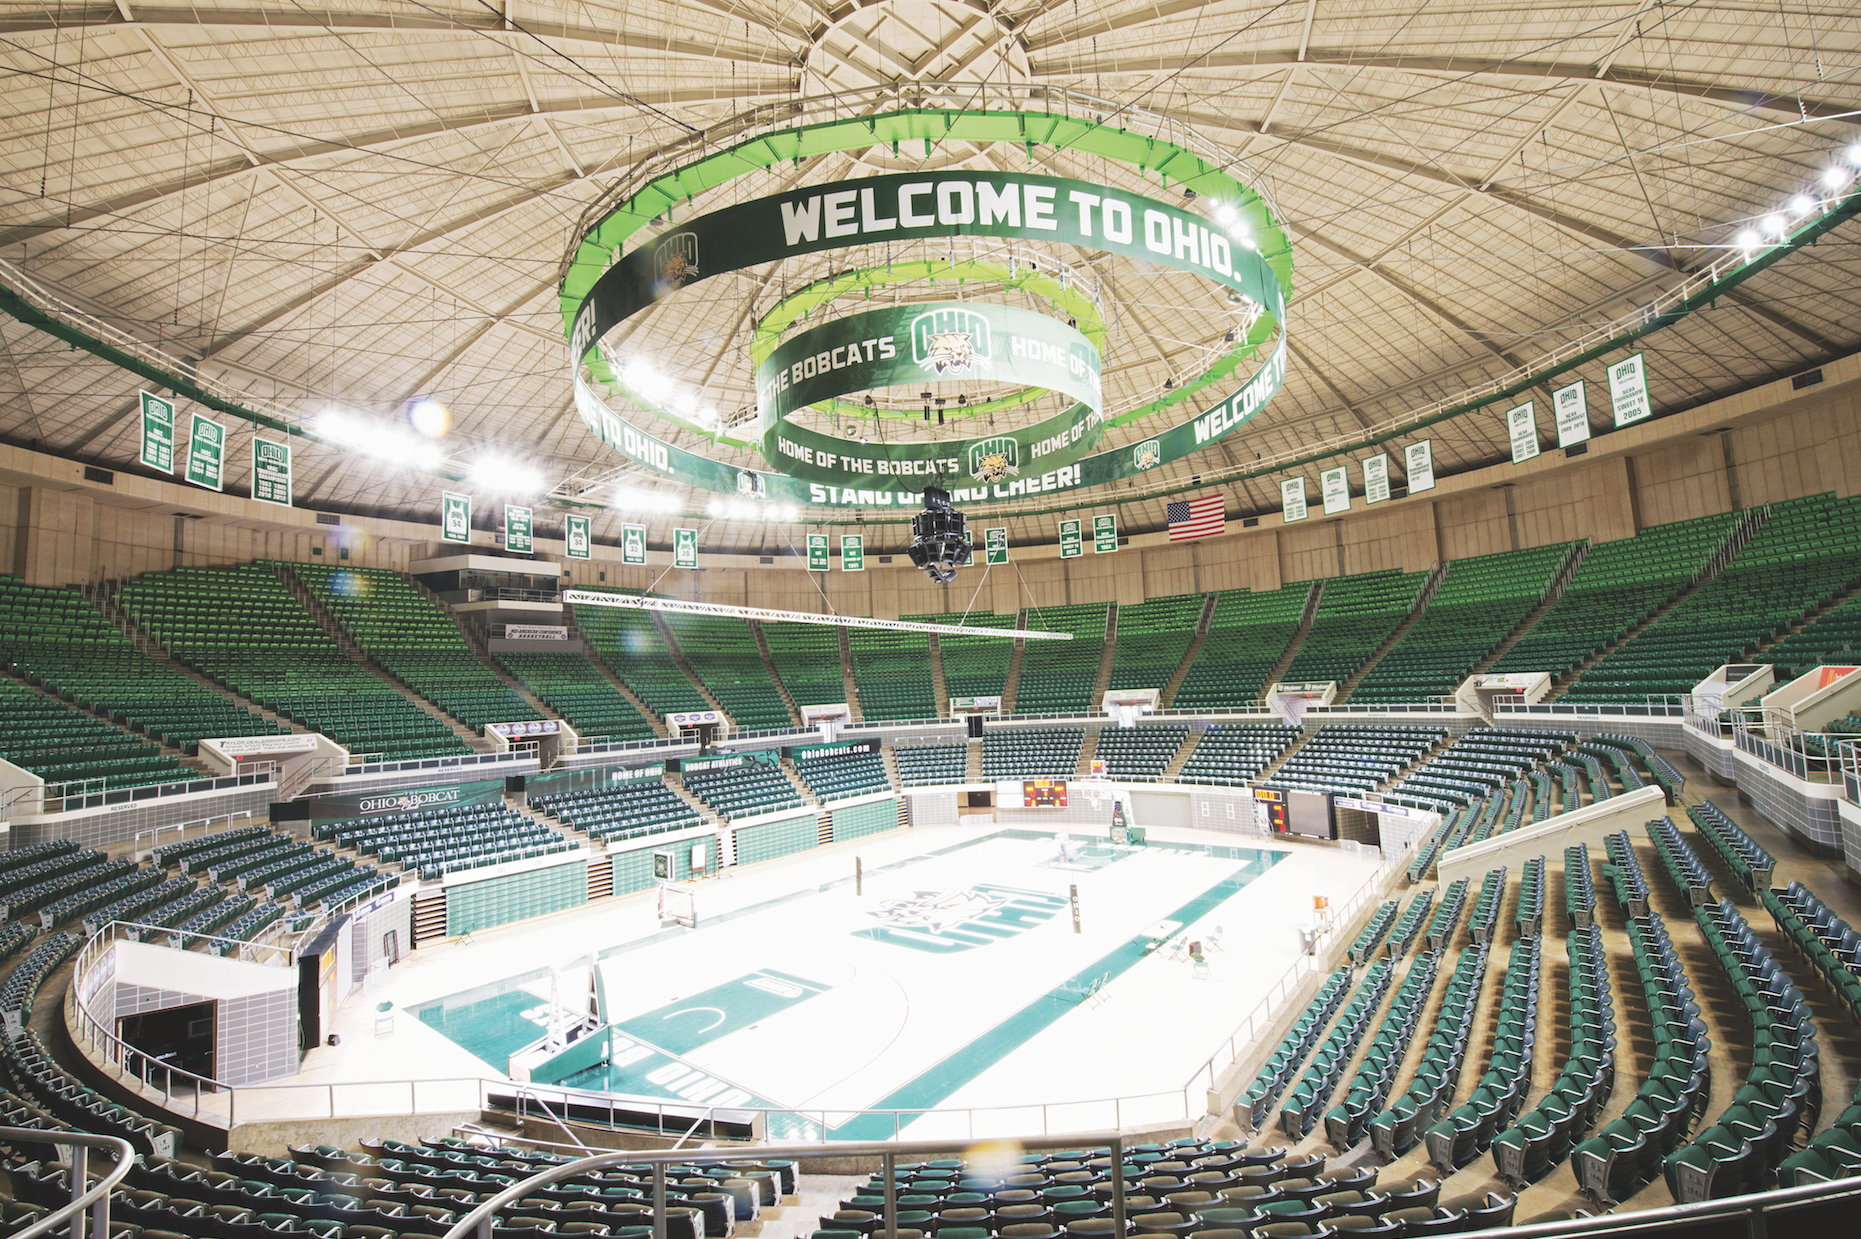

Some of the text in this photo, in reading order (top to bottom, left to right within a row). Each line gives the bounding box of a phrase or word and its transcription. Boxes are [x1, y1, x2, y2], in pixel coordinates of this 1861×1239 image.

[780, 180, 1242, 283] WELCOME TO OHIO.
[911, 307, 993, 364] OHIO
[791, 336, 896, 384] BOBCATS
[1011, 335, 1086, 378] HOME OF
[1616, 363, 1636, 380] OHIO
[1560, 389, 1578, 404] OHIO
[1614, 387, 1644, 403] TOURNAMENT
[1622, 386, 1636, 395] NCAA
[148, 400, 168, 421] OHIO
[1193, 363, 1274, 445] WELCOME
[1617, 400, 1636, 411] SWEET
[1513, 409, 1528, 423] OHIO
[1558, 412, 1586, 426] TOURNAMENT
[1565, 411, 1577, 419] NCAA
[1623, 407, 1642, 420] 2005
[198, 422, 218, 442] OHIO
[1031, 420, 1085, 459] HOME OF
[600, 407, 675, 474] TO OHIO.
[261, 445, 283, 462] OHIO
[778, 436, 960, 476] HOME OF THE BOBCATS
[968, 437, 1019, 472] OHIO
[1411, 446, 1425, 458] OHIO
[1327, 472, 1341, 482] OHIO
[802, 744, 870, 760] OhioBobcats.com
[685, 757, 743, 772] BOBCAT ATHLETICS
[612, 767, 663, 781] HOME OF OHIO
[110, 803, 138, 811] RESERVED
[360, 790, 460, 811] OHIO BOBCAT
